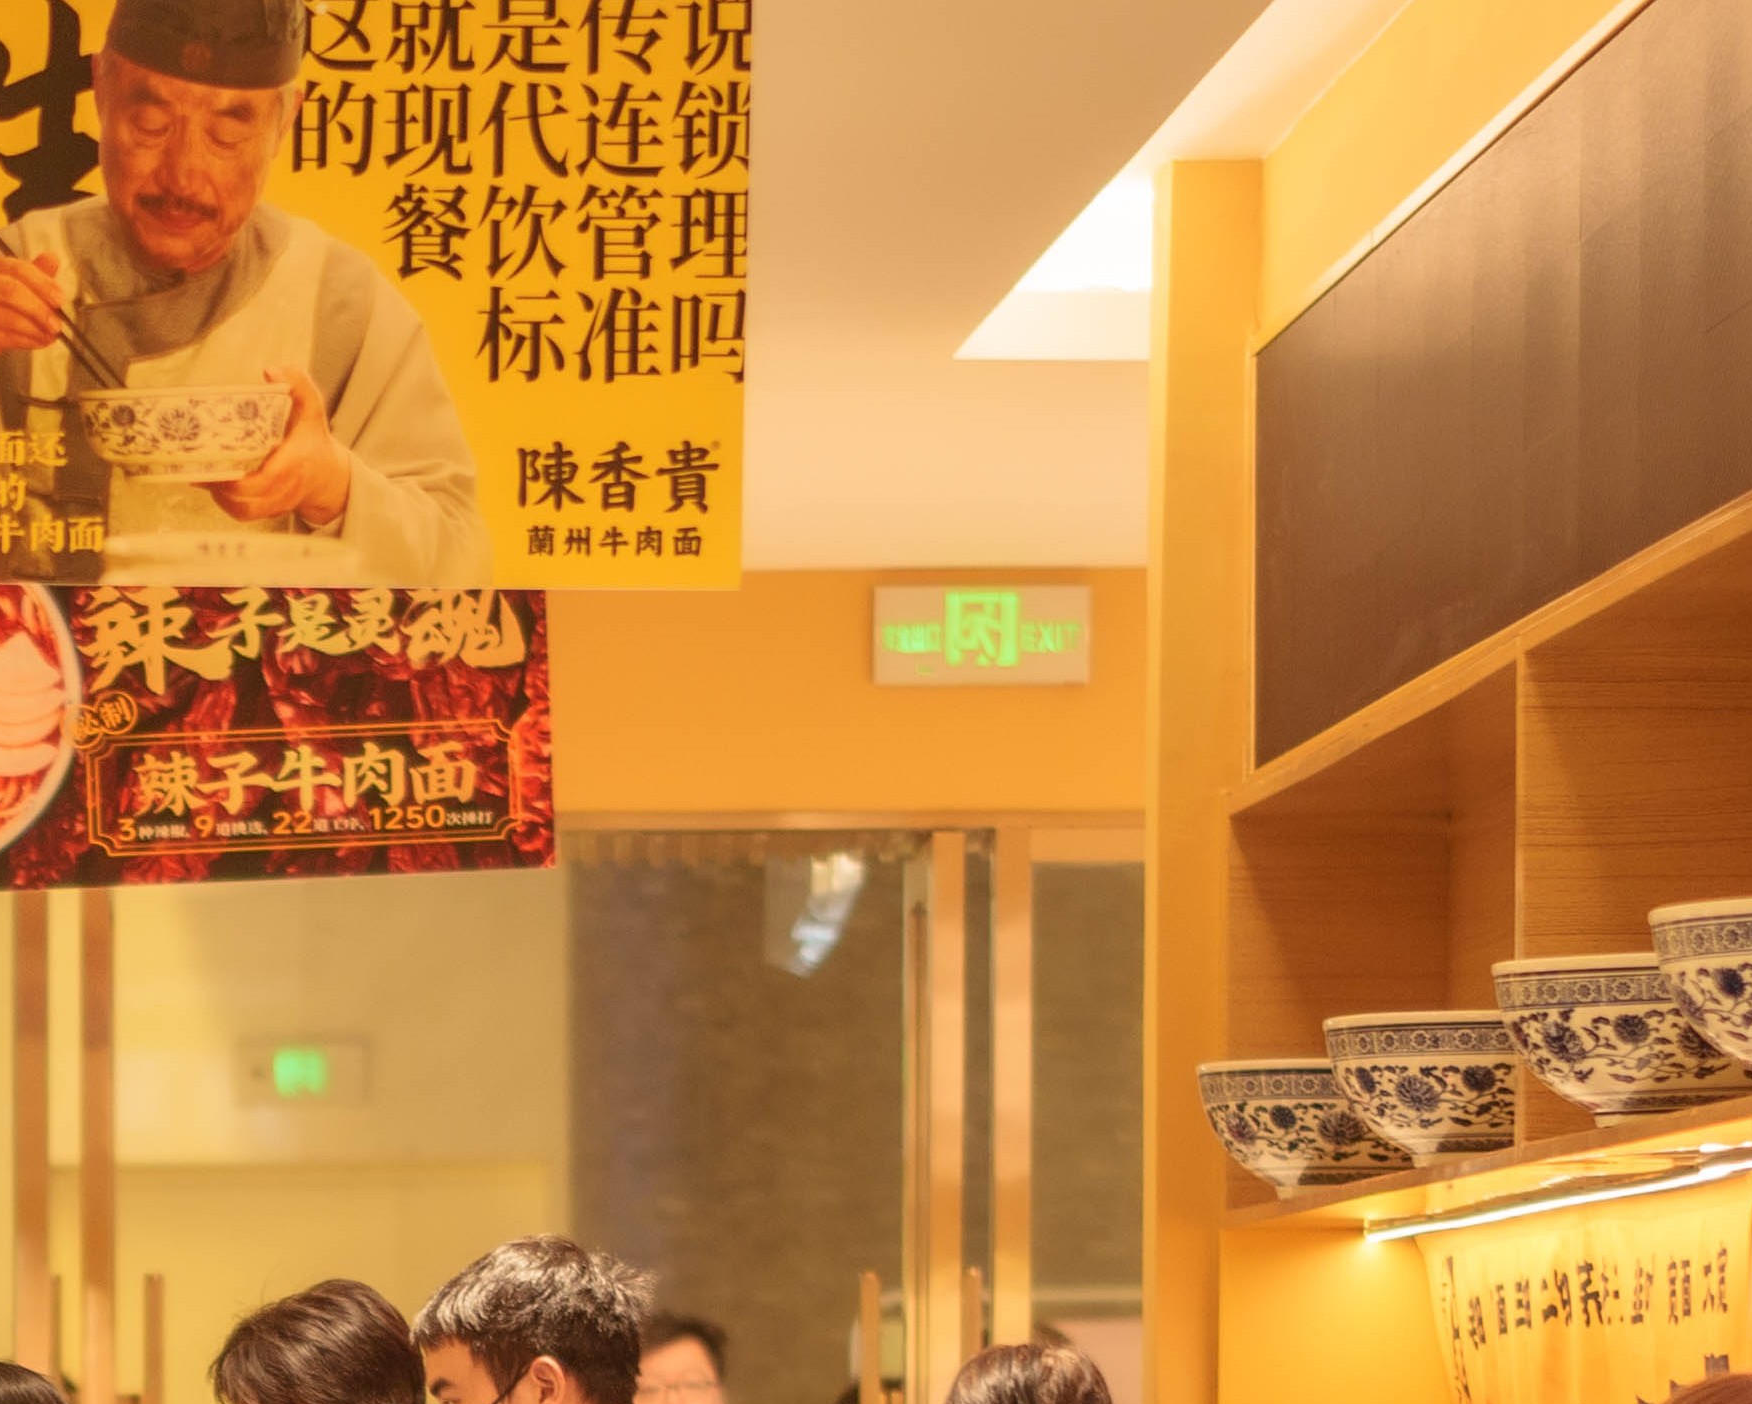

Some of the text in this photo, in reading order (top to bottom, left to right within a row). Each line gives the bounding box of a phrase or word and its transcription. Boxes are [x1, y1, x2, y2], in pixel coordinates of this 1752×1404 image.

[304, 0, 752, 76] 这就是传说
[291, 80, 752, 178] 的现代连锁
[383, 184, 748, 281] 餐饮管理
[475, 286, 745, 383] 标准吗
[516, 440, 720, 514] 陳香貴
[526, 525, 703, 557] 蘭州牛肉面
[77, 586, 527, 695] 辣子是灵魂
[1022, 622, 1081, 653] EXIT
[132, 740, 477, 817] 辣子牛肉面
